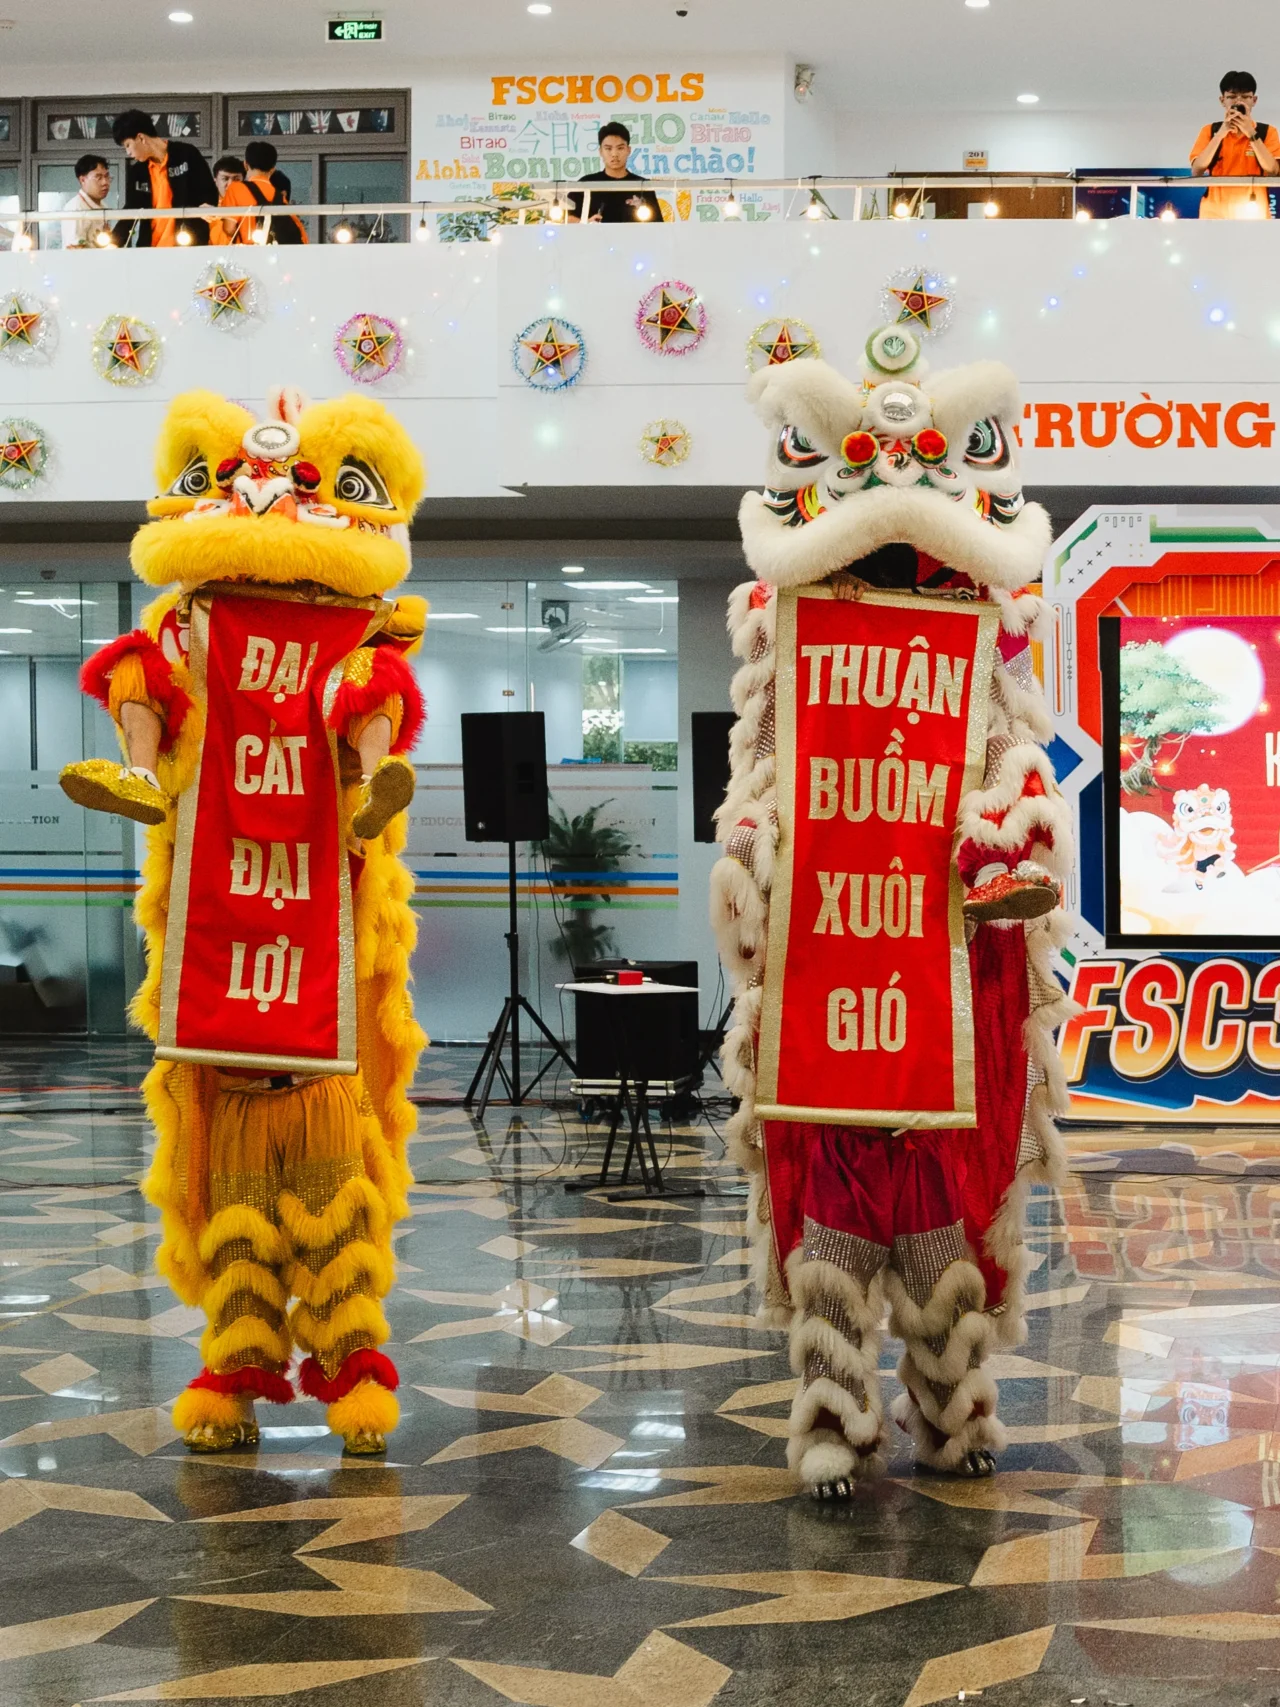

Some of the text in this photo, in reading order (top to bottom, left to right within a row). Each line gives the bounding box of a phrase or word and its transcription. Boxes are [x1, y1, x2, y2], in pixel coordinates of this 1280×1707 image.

[491, 73, 705, 106] FSCHOOLS
[416, 159, 481, 180] Aloha
[483, 153, 601, 181] Bonjou
[674, 146, 756, 174] chào!
[236, 635, 319, 704] ĐẠI
[801, 635, 968, 725] THUẬN
[807, 728, 951, 828] BUỒM
[229, 837, 311, 911] ĐẠI
[812, 856, 926, 939] XUÔI
[225, 934, 305, 1013] LỢI
[826, 970, 907, 1053] GIÓ
